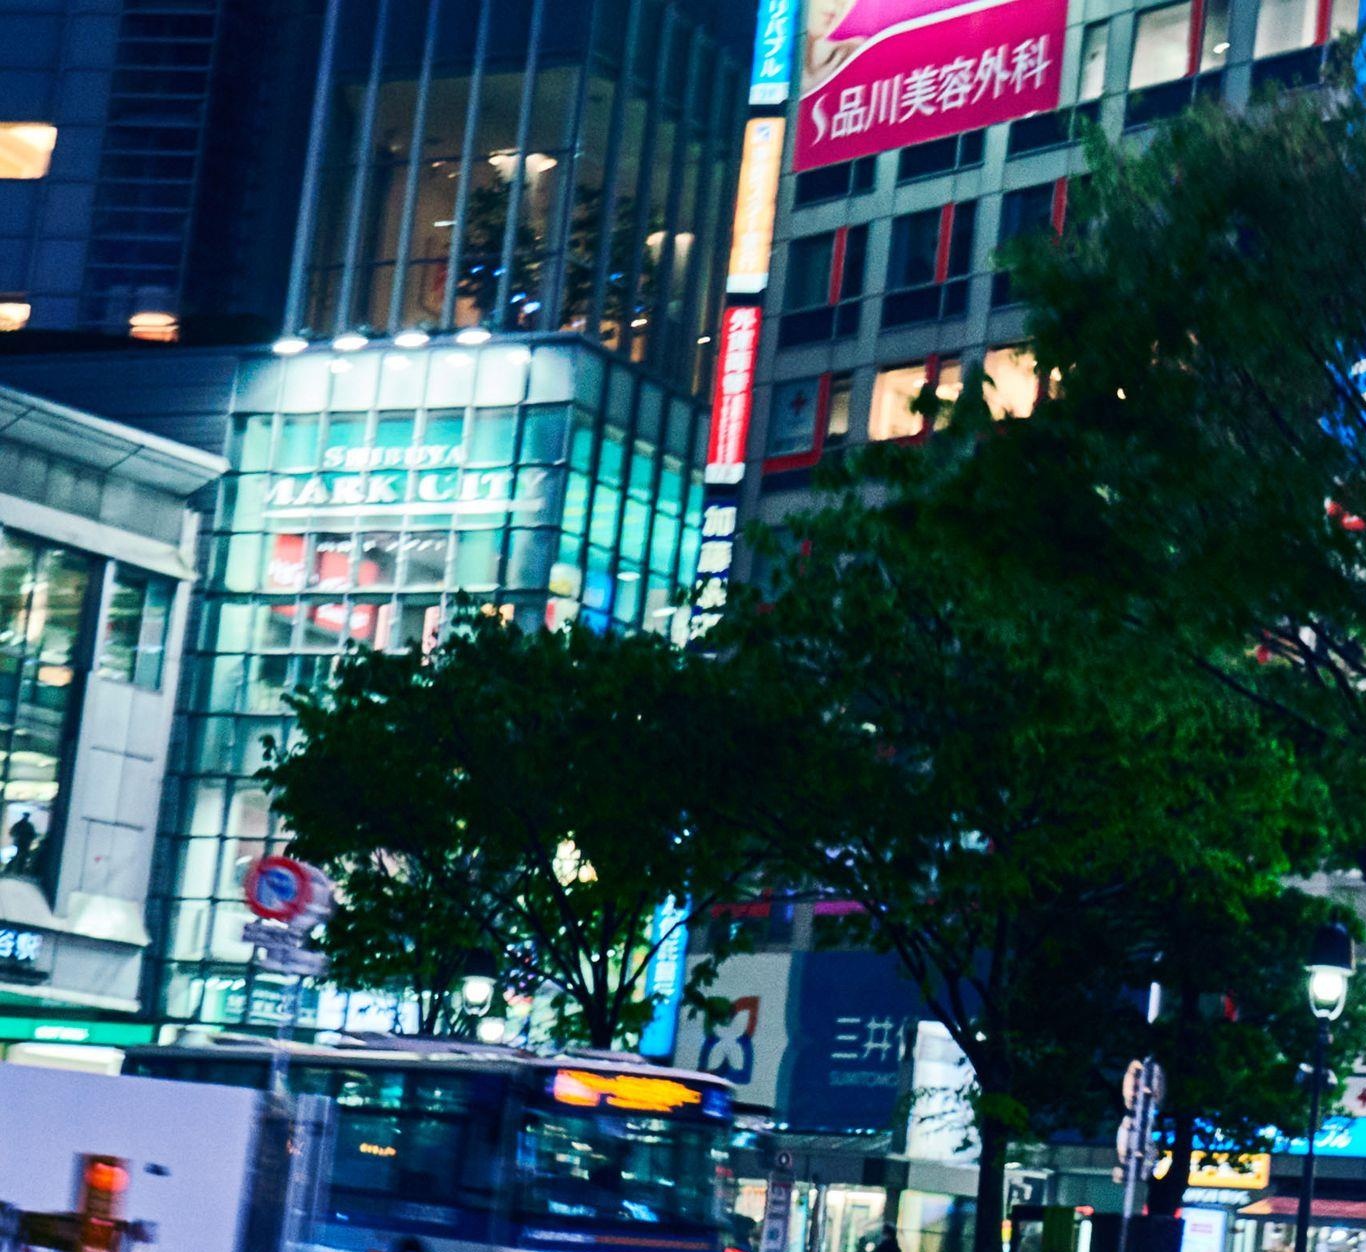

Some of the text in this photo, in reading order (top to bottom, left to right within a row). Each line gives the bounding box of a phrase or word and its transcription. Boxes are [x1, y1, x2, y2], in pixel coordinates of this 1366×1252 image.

[830, 34, 1053, 141] 品川美容外科
[323, 444, 464, 469] SHIBUYA
[264, 467, 550, 505] MARK CITY
